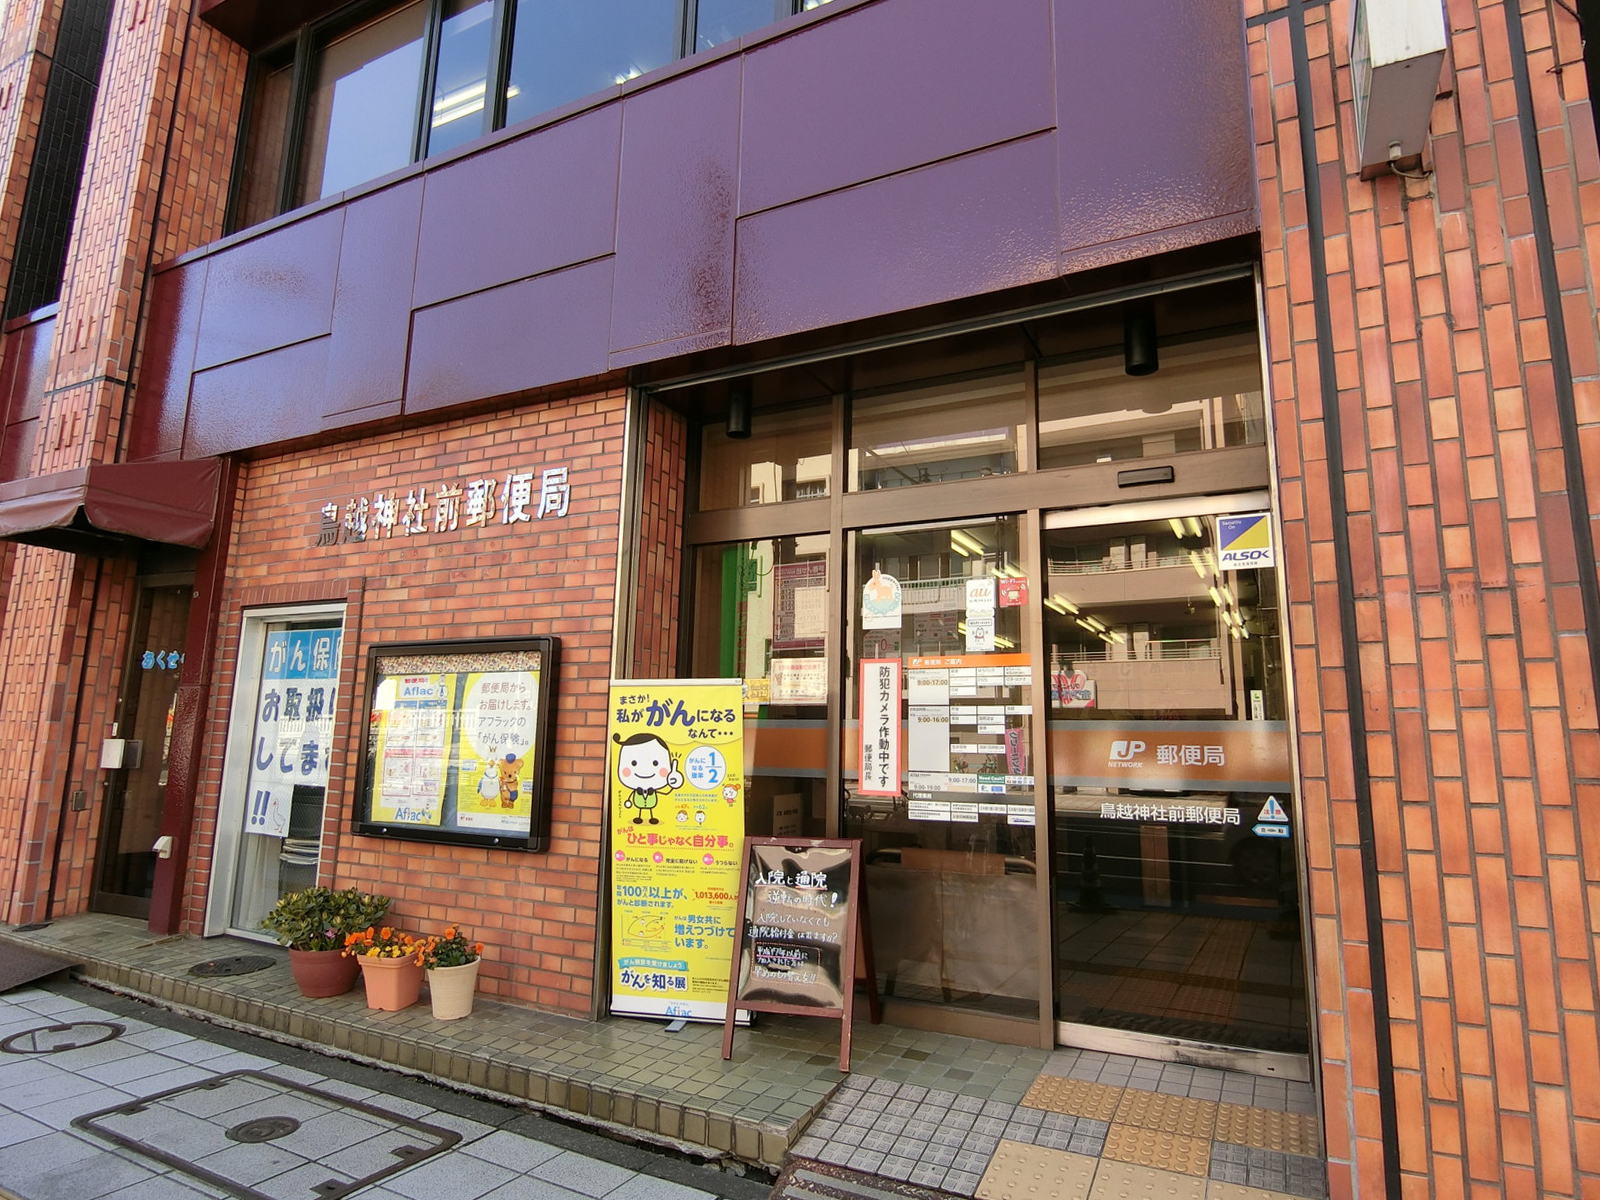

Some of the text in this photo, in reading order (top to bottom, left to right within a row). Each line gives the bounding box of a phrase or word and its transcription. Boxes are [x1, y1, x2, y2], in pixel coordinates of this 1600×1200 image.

[314, 466, 571, 548] 鳥越神社前郵便局
[1222, 549, 1270, 561] ALSOK
[970, 587, 992, 598] au
[141, 650, 185, 670] あくせ
[403, 686, 434, 696] Aflac
[480, 682, 527, 694] 郵便局から
[479, 699, 531, 711] お届けします。
[619, 693, 650, 705] まさか!
[616, 698, 736, 727] 私ががんになる
[478, 716, 527, 727] アフラックの
[878, 665, 890, 788] 防犯カメラ作動中です
[1110, 740, 1226, 767] JP 郵便局
[864, 744, 873, 781] 郵便局長
[1107, 760, 1144, 768] NETWORK
[708, 768, 719, 783] 2
[394, 807, 421, 821] Aflac
[1100, 802, 1241, 825] 鳥越神社前郵便局
[627, 833, 734, 848] ひと事じゃなく自分事。
[754, 870, 829, 889] 入院と通院
[617, 898, 674, 908] がんと診断されます。
[768, 889, 839, 908] 逆転の時代!
[757, 913, 830, 928] 入院していなくても
[674, 923, 735, 938] 増えつづけて
[675, 937, 708, 950] います。
[621, 970, 686, 990] がんを知る展
[665, 1005, 692, 1017] Aflac
